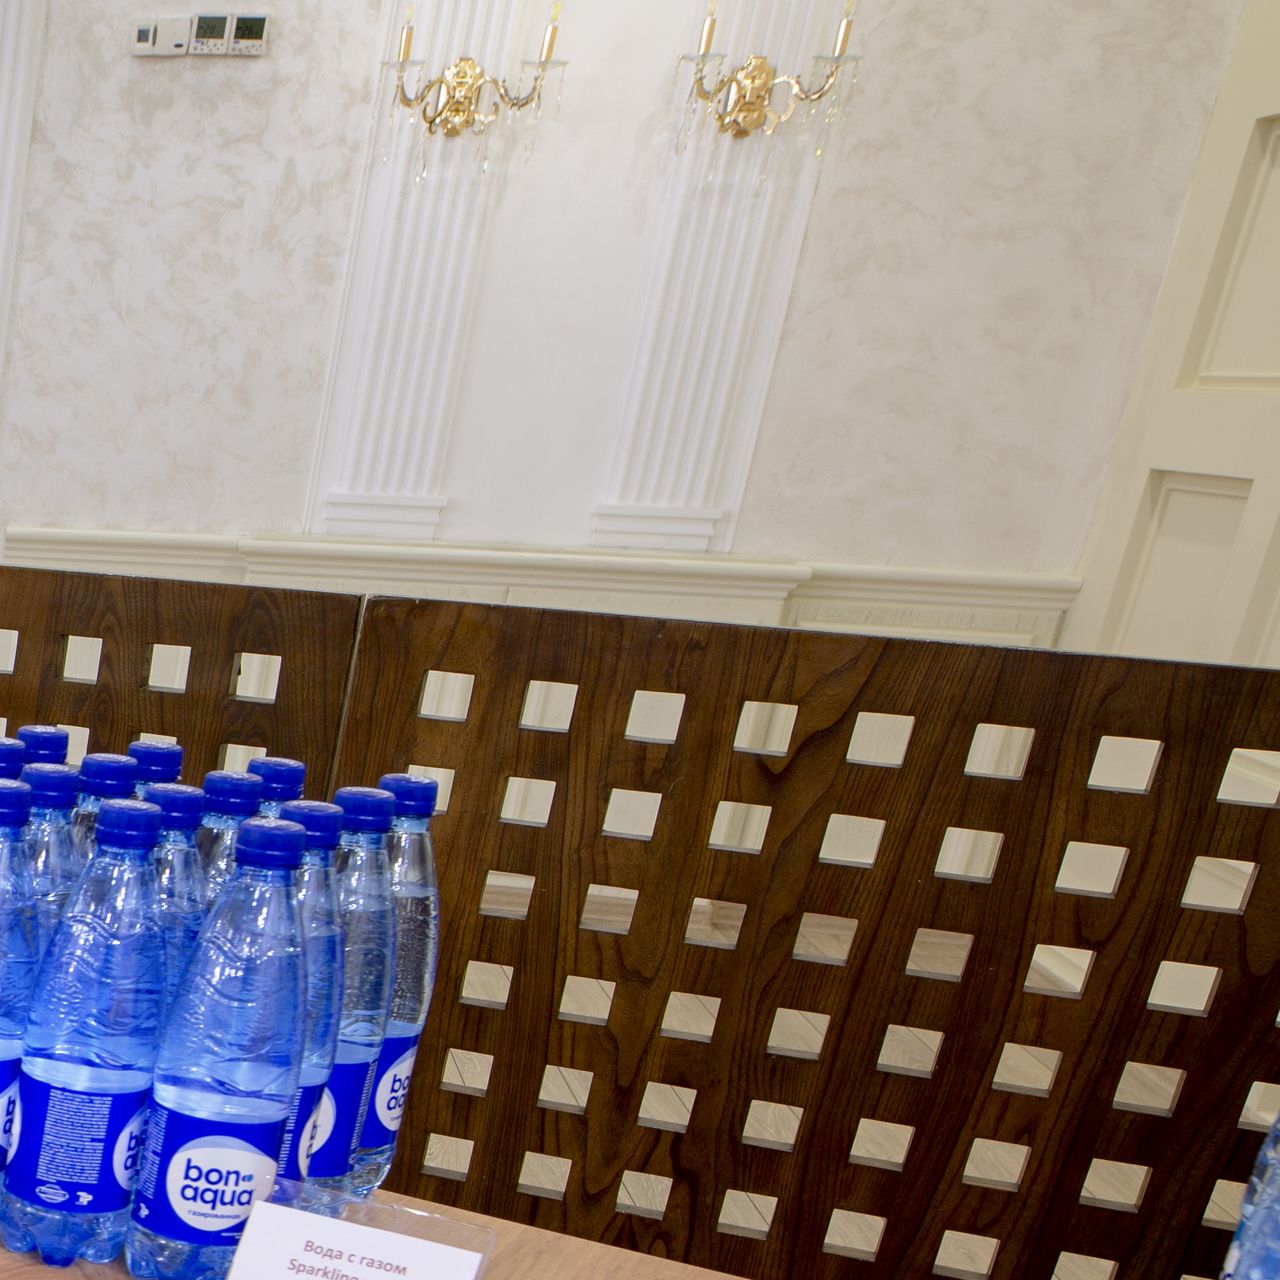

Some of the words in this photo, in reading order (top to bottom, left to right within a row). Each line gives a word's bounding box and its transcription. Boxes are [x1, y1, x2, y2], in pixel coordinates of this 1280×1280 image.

[184, 1158, 241, 1187] bon
[180, 1184, 255, 1211] aqua
[303, 1240, 344, 1261] Вода
[347, 1252, 357, 1264] с
[359, 1255, 407, 1277] газом
